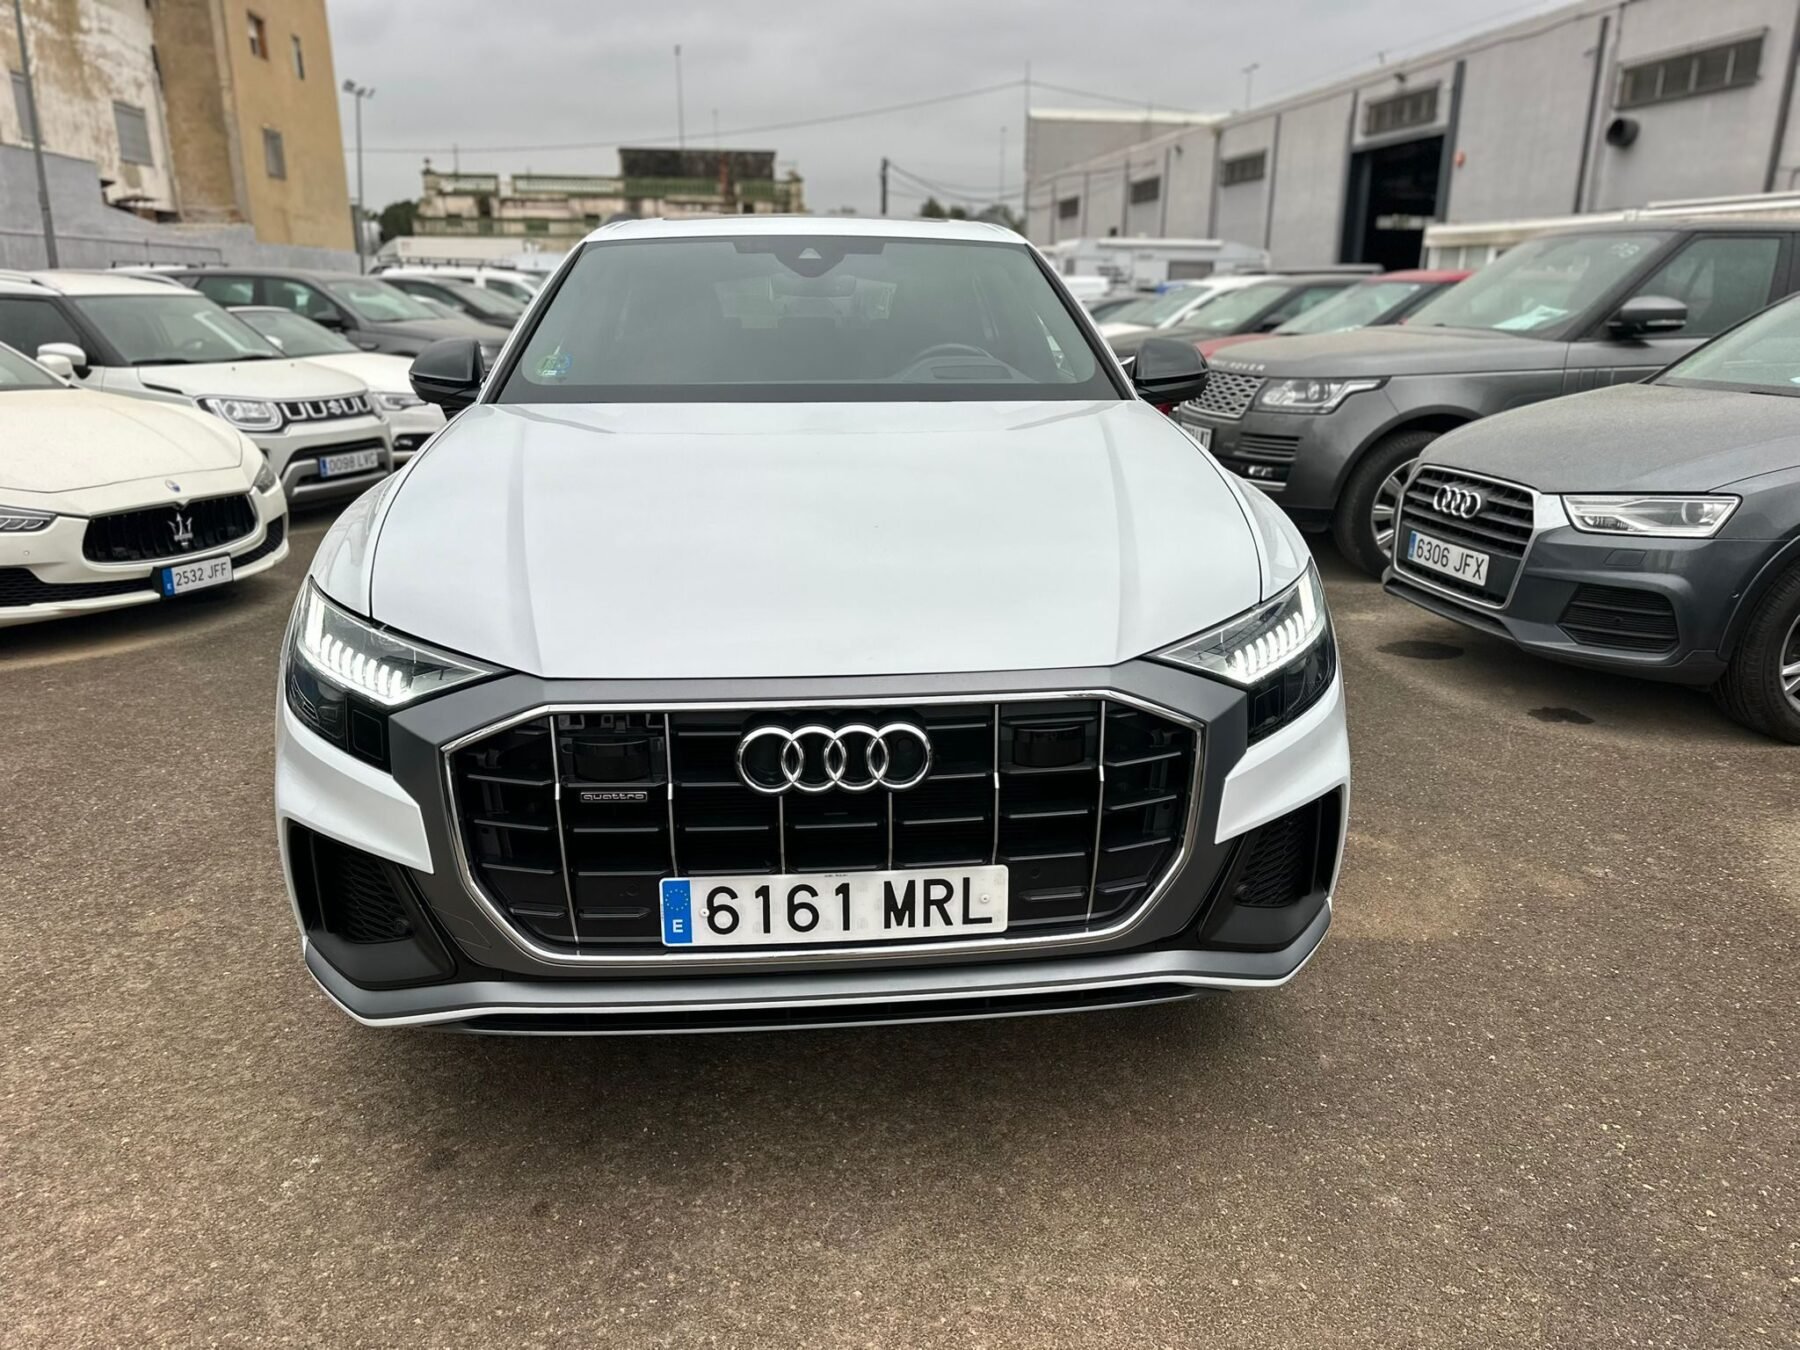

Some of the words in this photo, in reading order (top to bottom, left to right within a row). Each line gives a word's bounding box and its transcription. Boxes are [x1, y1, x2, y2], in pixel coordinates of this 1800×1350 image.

[1416, 538, 1450, 568] 6306
[1453, 552, 1485, 580] JFX
[175, 567, 205, 587] 2532
[207, 562, 227, 579] JFF
[583, 793, 644, 801] quattro
[706, 883, 850, 935] 6161
[884, 877, 993, 929] MRL
[673, 919, 684, 933] E
